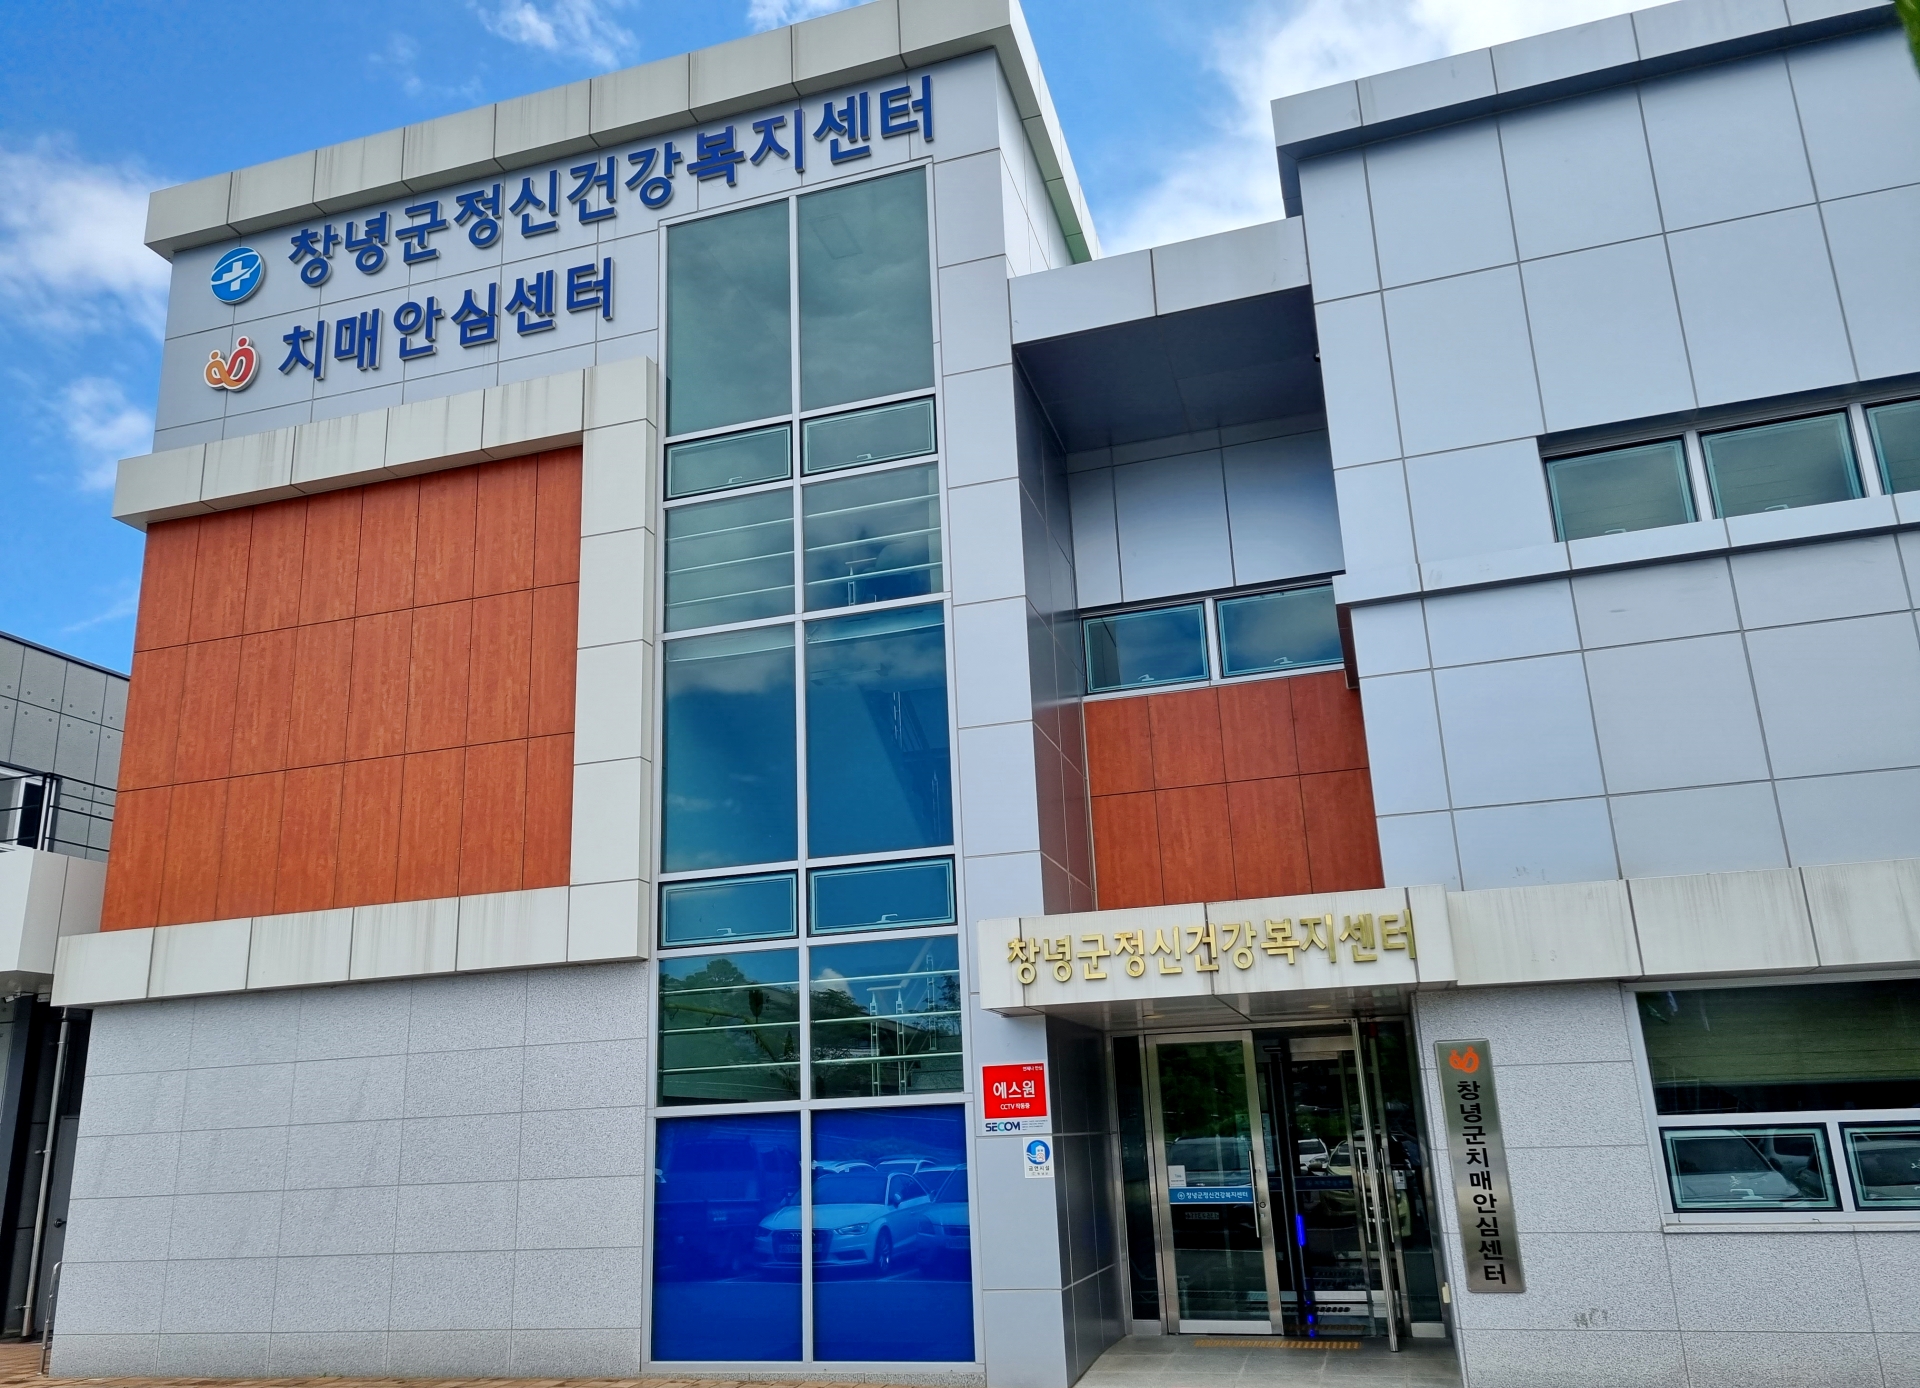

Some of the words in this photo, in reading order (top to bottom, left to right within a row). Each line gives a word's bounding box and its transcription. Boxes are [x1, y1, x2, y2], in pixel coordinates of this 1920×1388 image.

[288, 75, 934, 287] 창녕군정신건강복지센터
[278, 256, 615, 381] 치매안심센터
[1007, 908, 1416, 985] 창녕군정신건강복지센터
[985, 1121, 1020, 1132] SECOM
[993, 1080, 1036, 1099] 에스원
[1457, 1080, 1507, 1285] 창녕군치매안심센터
